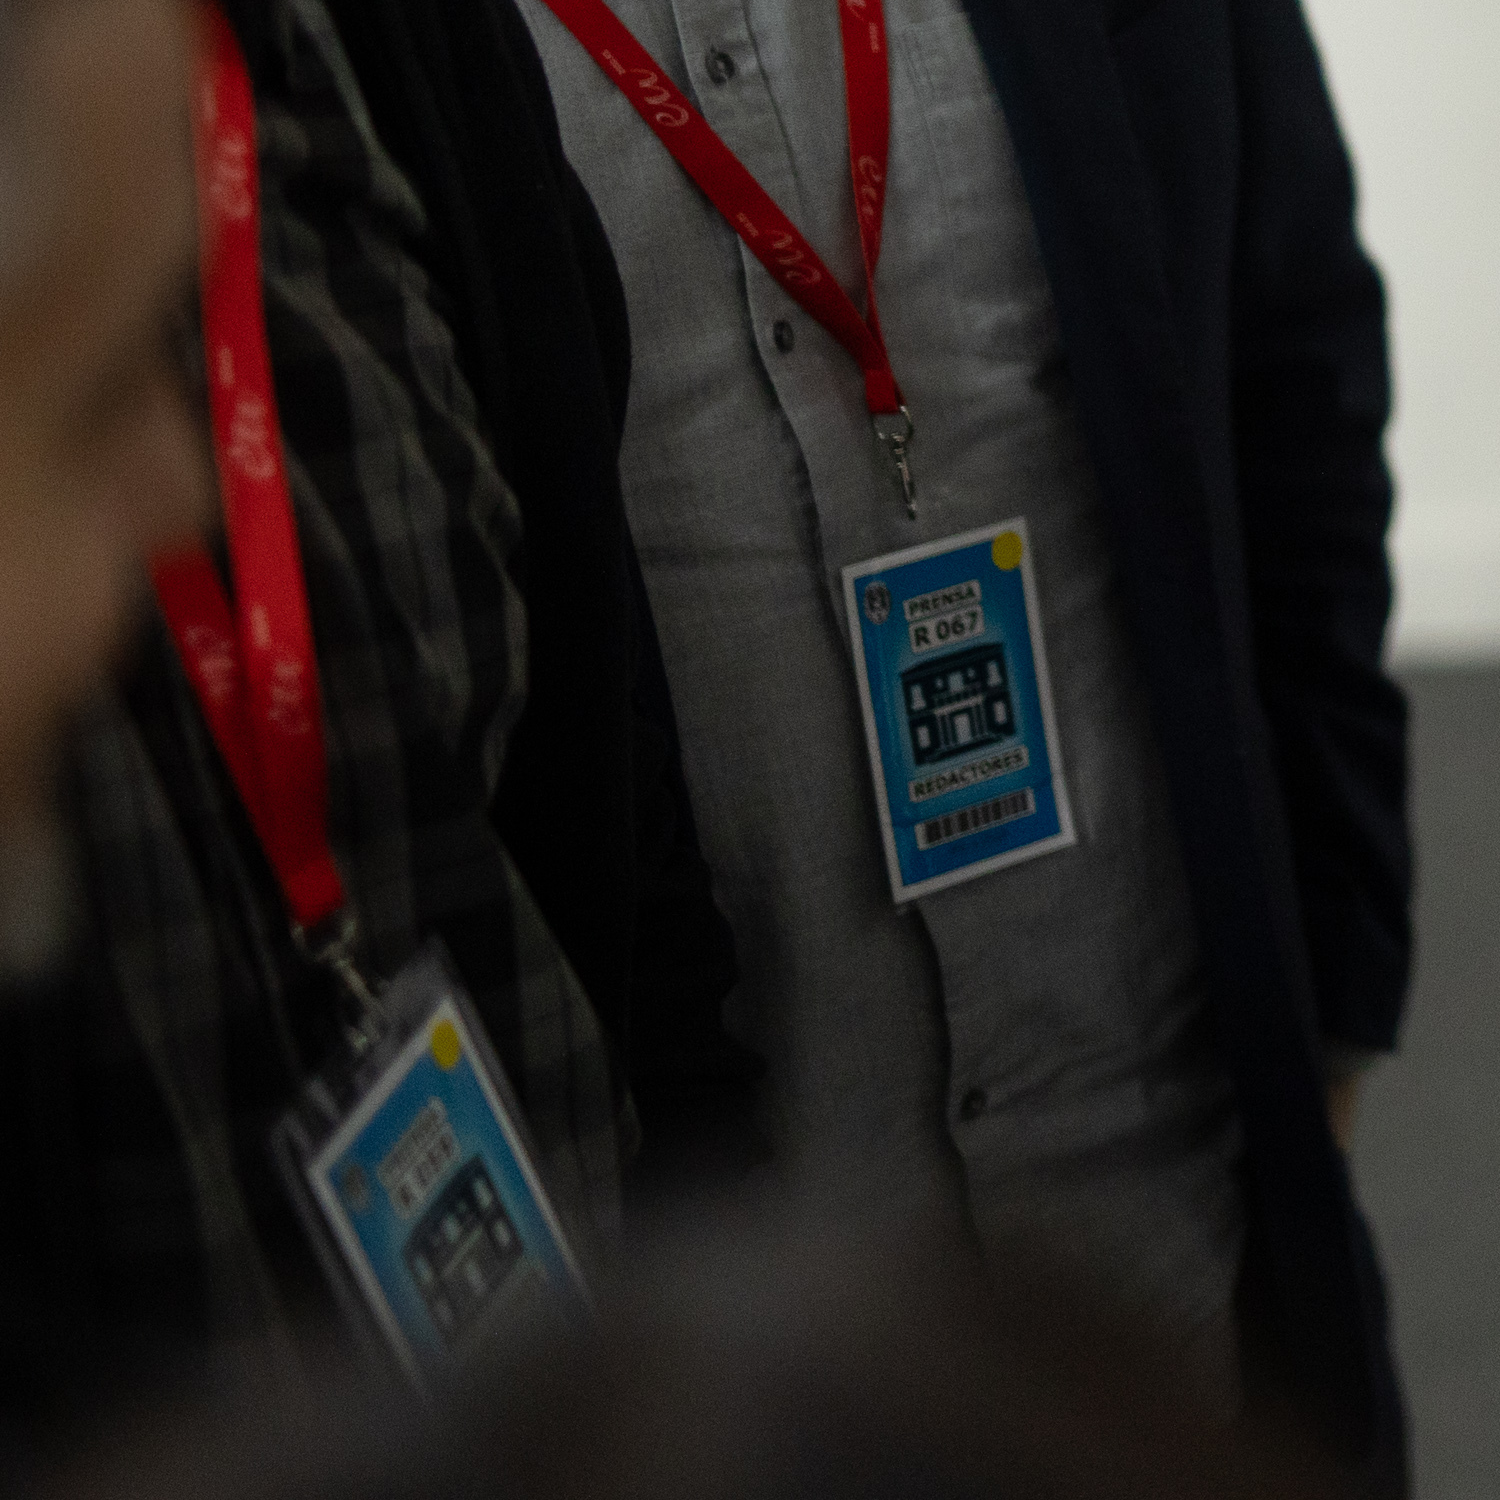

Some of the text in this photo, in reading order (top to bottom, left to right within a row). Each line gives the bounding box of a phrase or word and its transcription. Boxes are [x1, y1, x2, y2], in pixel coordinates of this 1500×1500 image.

[908, 586, 976, 616] PRENSA
[913, 611, 979, 647] R 067
[913, 752, 1023, 798] REDACTORES
